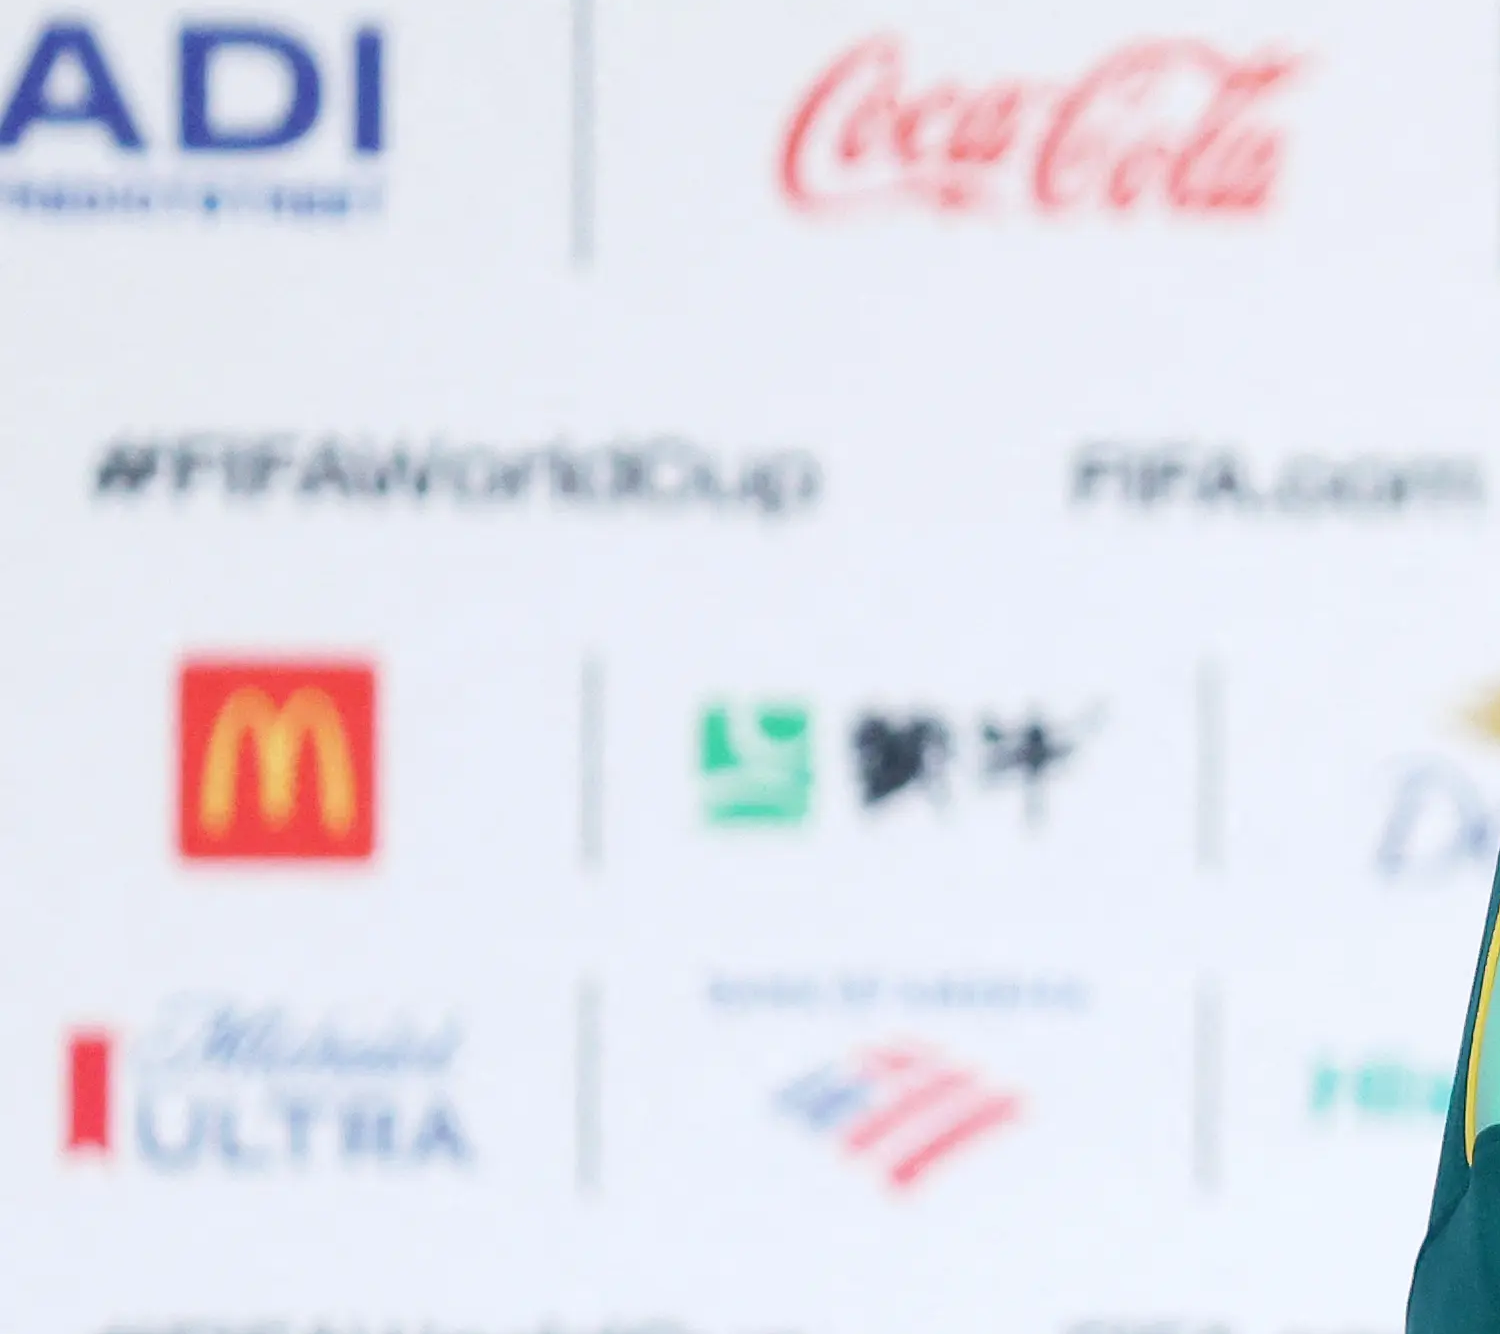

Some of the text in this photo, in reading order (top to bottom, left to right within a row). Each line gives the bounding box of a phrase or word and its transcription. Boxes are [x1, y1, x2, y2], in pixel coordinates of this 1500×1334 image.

[0, 16, 387, 159] ADI
[90, 432, 821, 519] #FIFAWorldCup
[1068, 441, 1485, 518] FIFA.com
[134, 1087, 474, 1174] ULTRA
